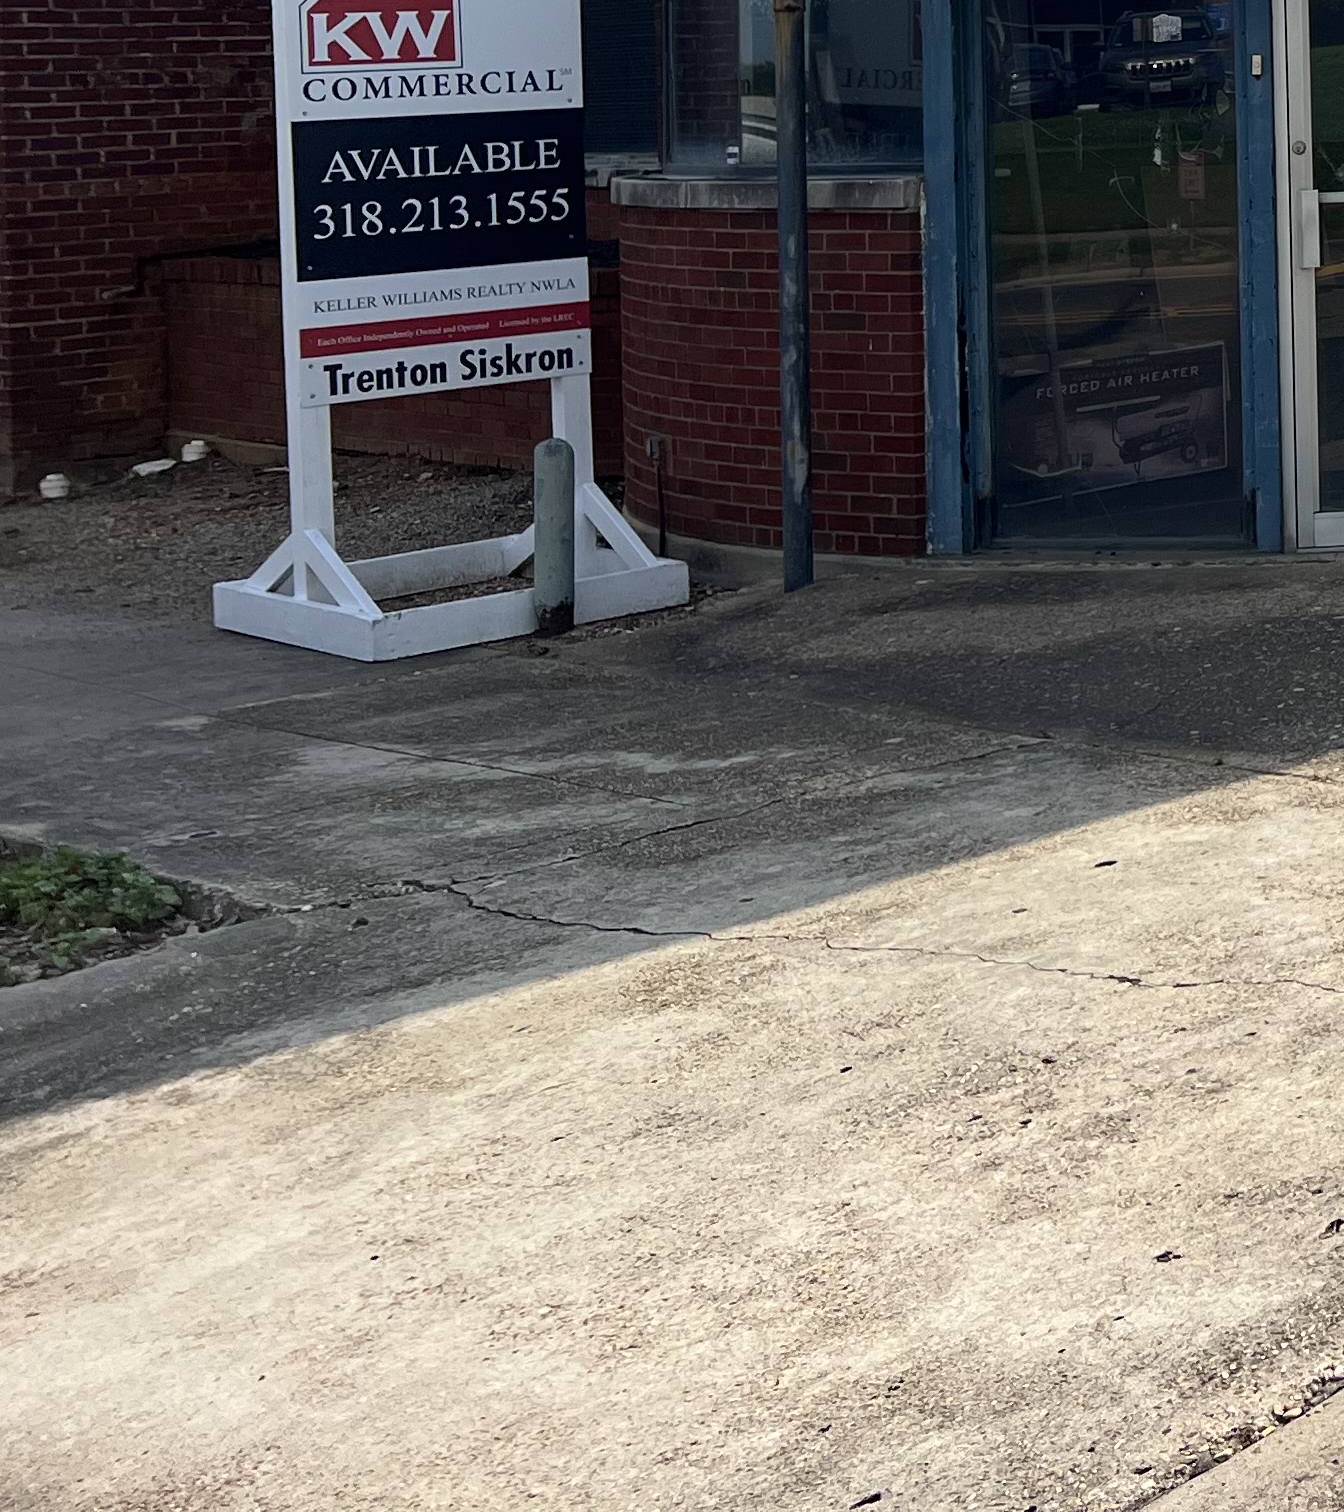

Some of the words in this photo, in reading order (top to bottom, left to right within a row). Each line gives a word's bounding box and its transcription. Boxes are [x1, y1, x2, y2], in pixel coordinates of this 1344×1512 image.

[310, 10, 450, 63] KW
[303, 69, 563, 102] COMMERCIAL
[322, 139, 561, 183] AVAILABLE
[313, 188, 570, 239] 318.213.1555
[313, 297, 378, 314] KELLER
[383, 288, 462, 306] WILLIAMS
[467, 282, 526, 299] REALTY
[531, 278, 576, 292] NWLA
[317, 338, 336, 347] Each
[338, 336, 362, 344] Office
[363, 330, 414, 342] Independently
[416, 327, 441, 336] Owned
[443, 325, 455, 333] and
[457, 321, 489, 333] Operated
[324, 361, 447, 396] Trenton
[460, 343, 573, 381] Siskron
[1107, 375, 1133, 389] AIR
[1140, 365, 1199, 384] HEATER
